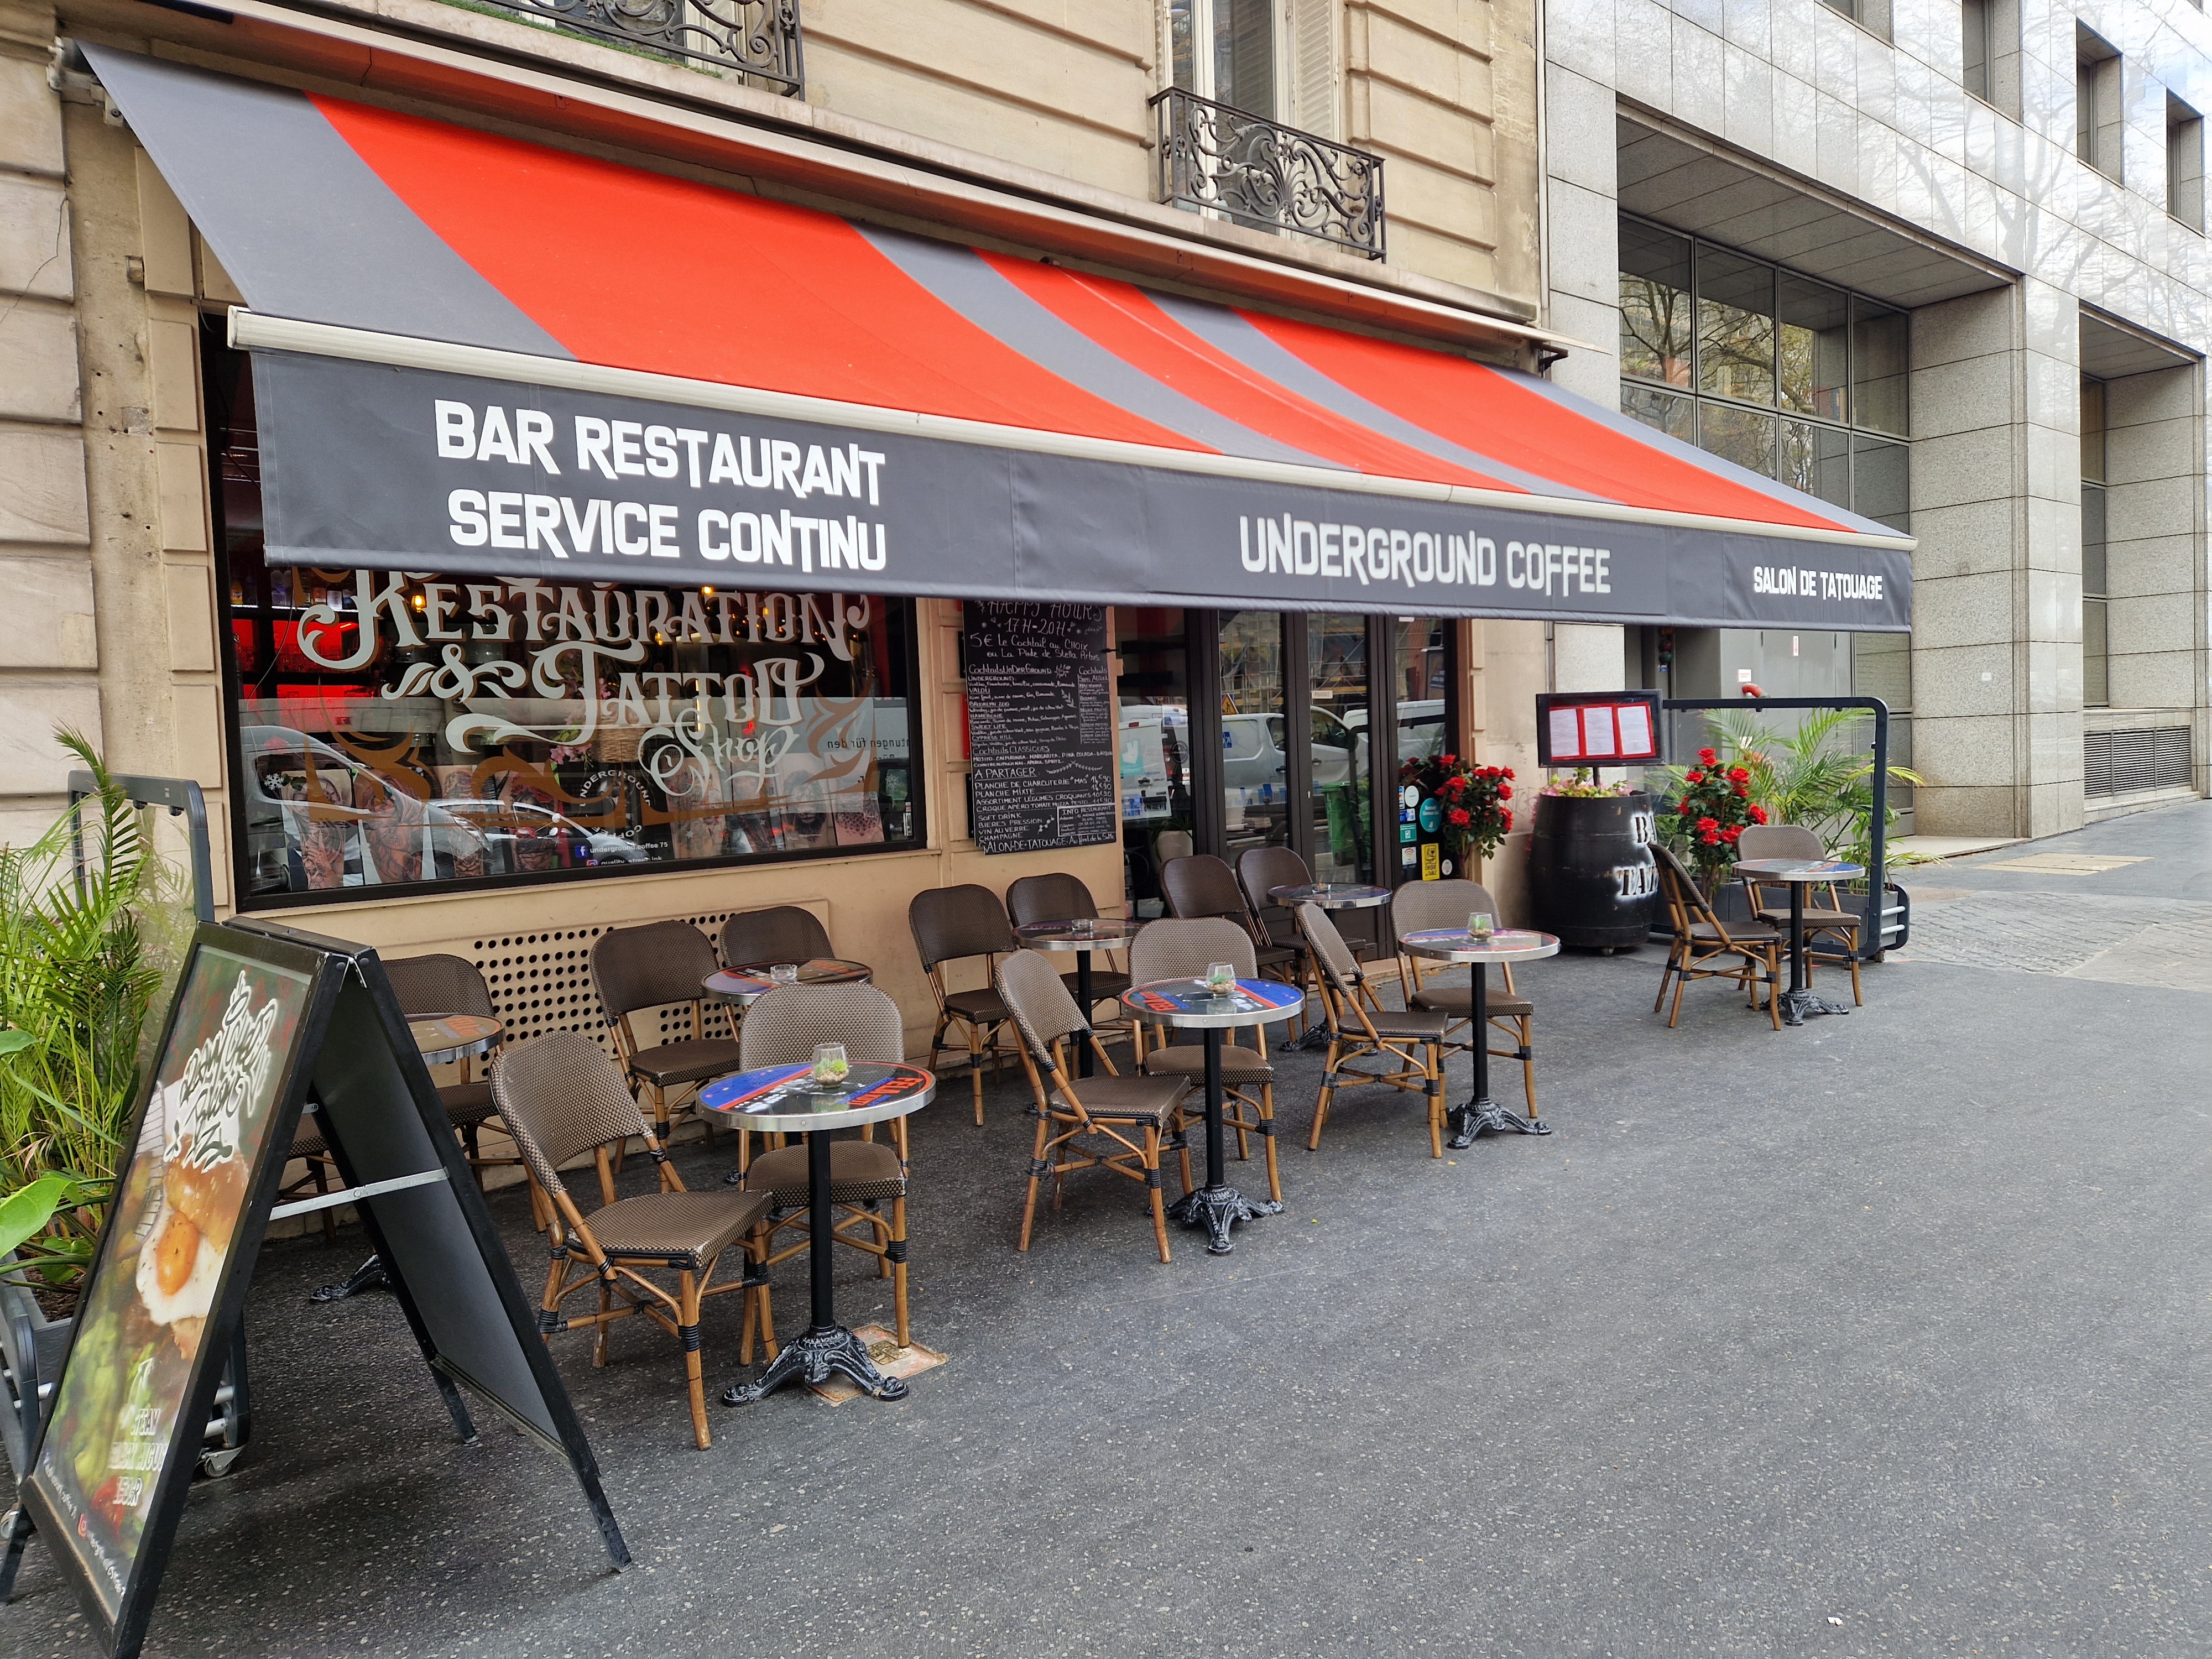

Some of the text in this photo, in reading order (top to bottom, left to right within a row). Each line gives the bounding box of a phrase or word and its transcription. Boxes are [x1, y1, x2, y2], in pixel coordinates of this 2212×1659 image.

[434, 399, 885, 506] BAR RESTAURANT
[448, 489, 886, 573] SERVICE CONTINU
[1240, 512, 1611, 597] UNDERGROUND COFFEE
[1754, 566, 1883, 601] SALON DE TATOUAGE
[970, 633, 994, 647] 5€
[1055, 649, 1078, 659] Stella
[985, 767, 1037, 779] PARTAGER
[974, 781, 1009, 790] PLANCHE
[975, 790, 1010, 798] PLANCHE
[979, 831, 1024, 842] CHAMPAGNE
